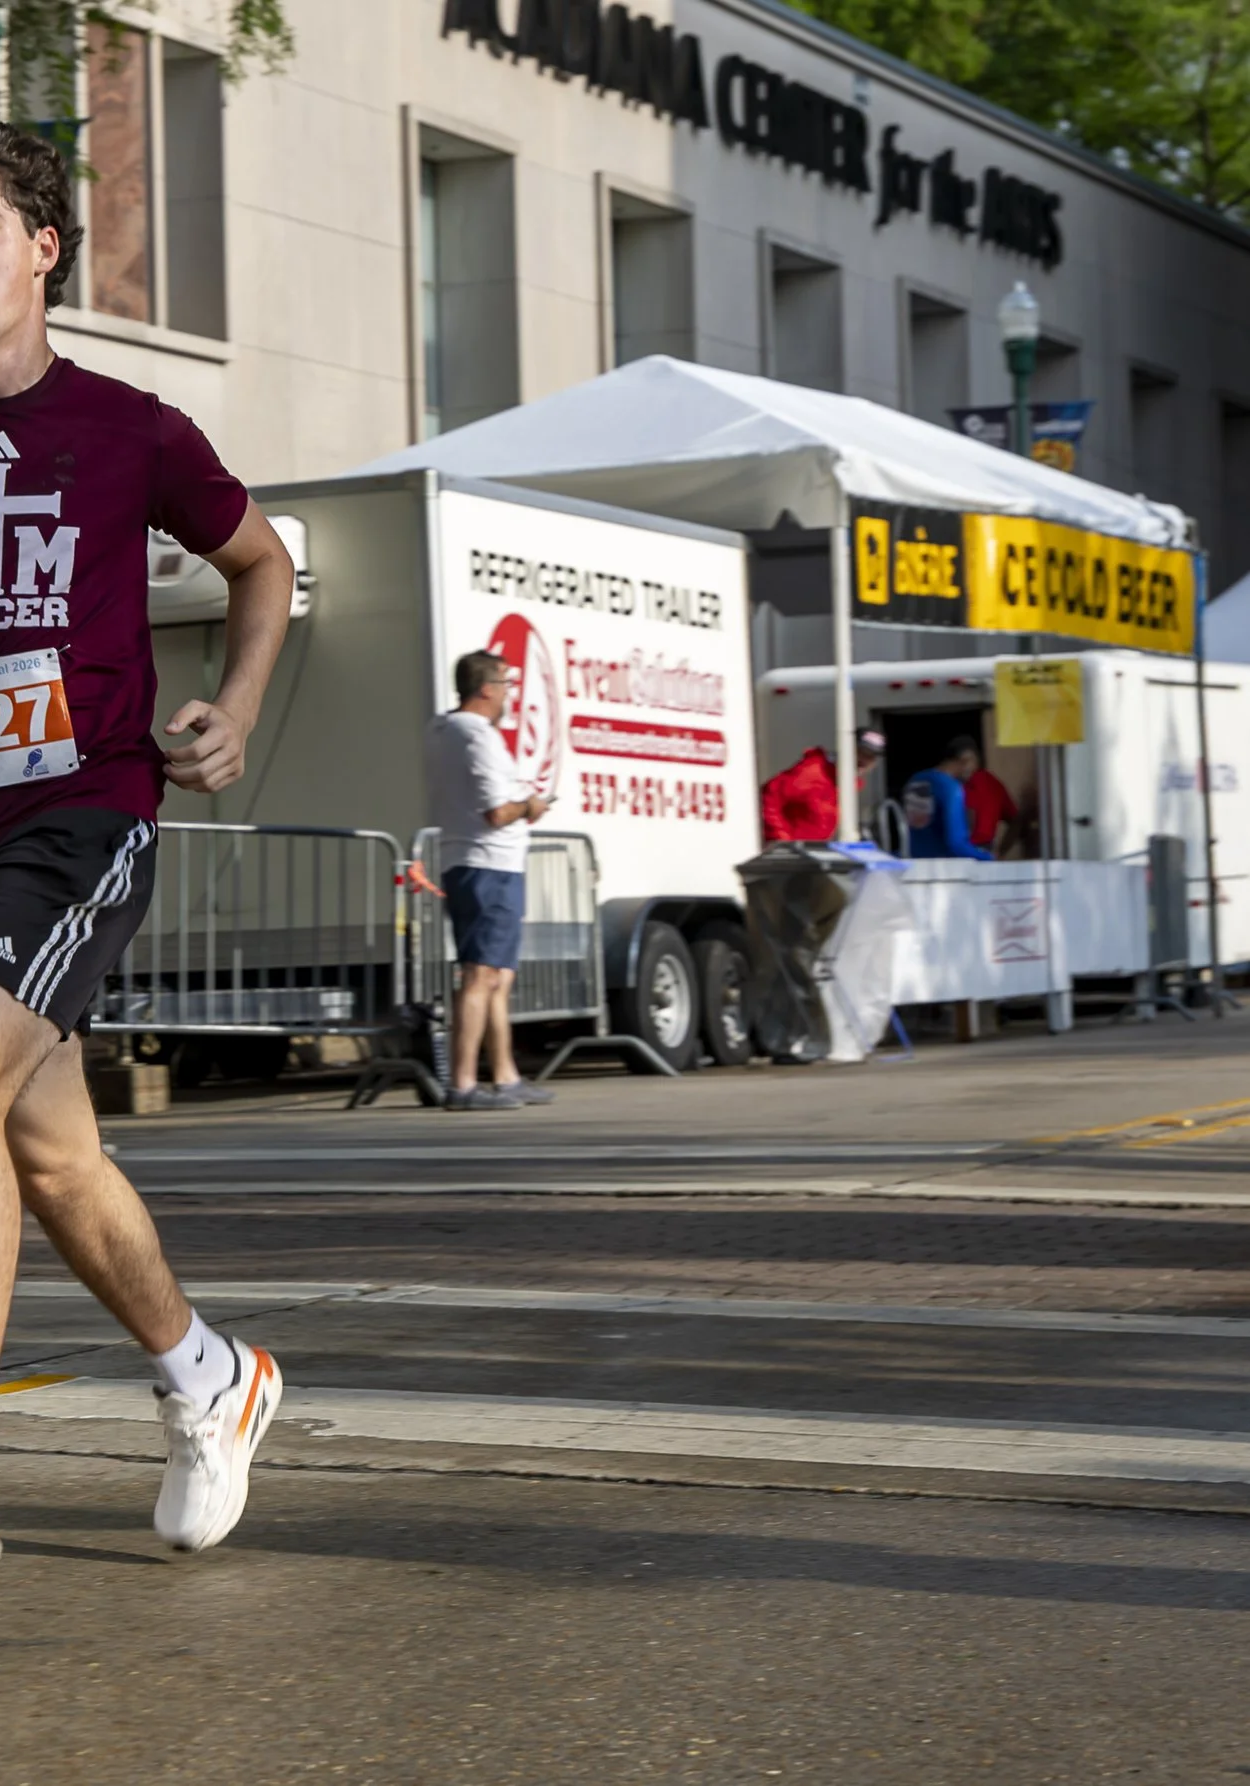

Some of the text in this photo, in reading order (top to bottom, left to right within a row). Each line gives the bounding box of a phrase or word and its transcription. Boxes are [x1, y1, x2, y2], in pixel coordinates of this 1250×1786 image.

[714, 54, 871, 195] CENTER
[877, 125, 929, 232] for
[470, 549, 724, 632] REFRIGERATED TRAILER
[1045, 548, 1109, 619] COLD
[1116, 564, 1180, 631] BEER
[12, 657, 41, 673] 2026
